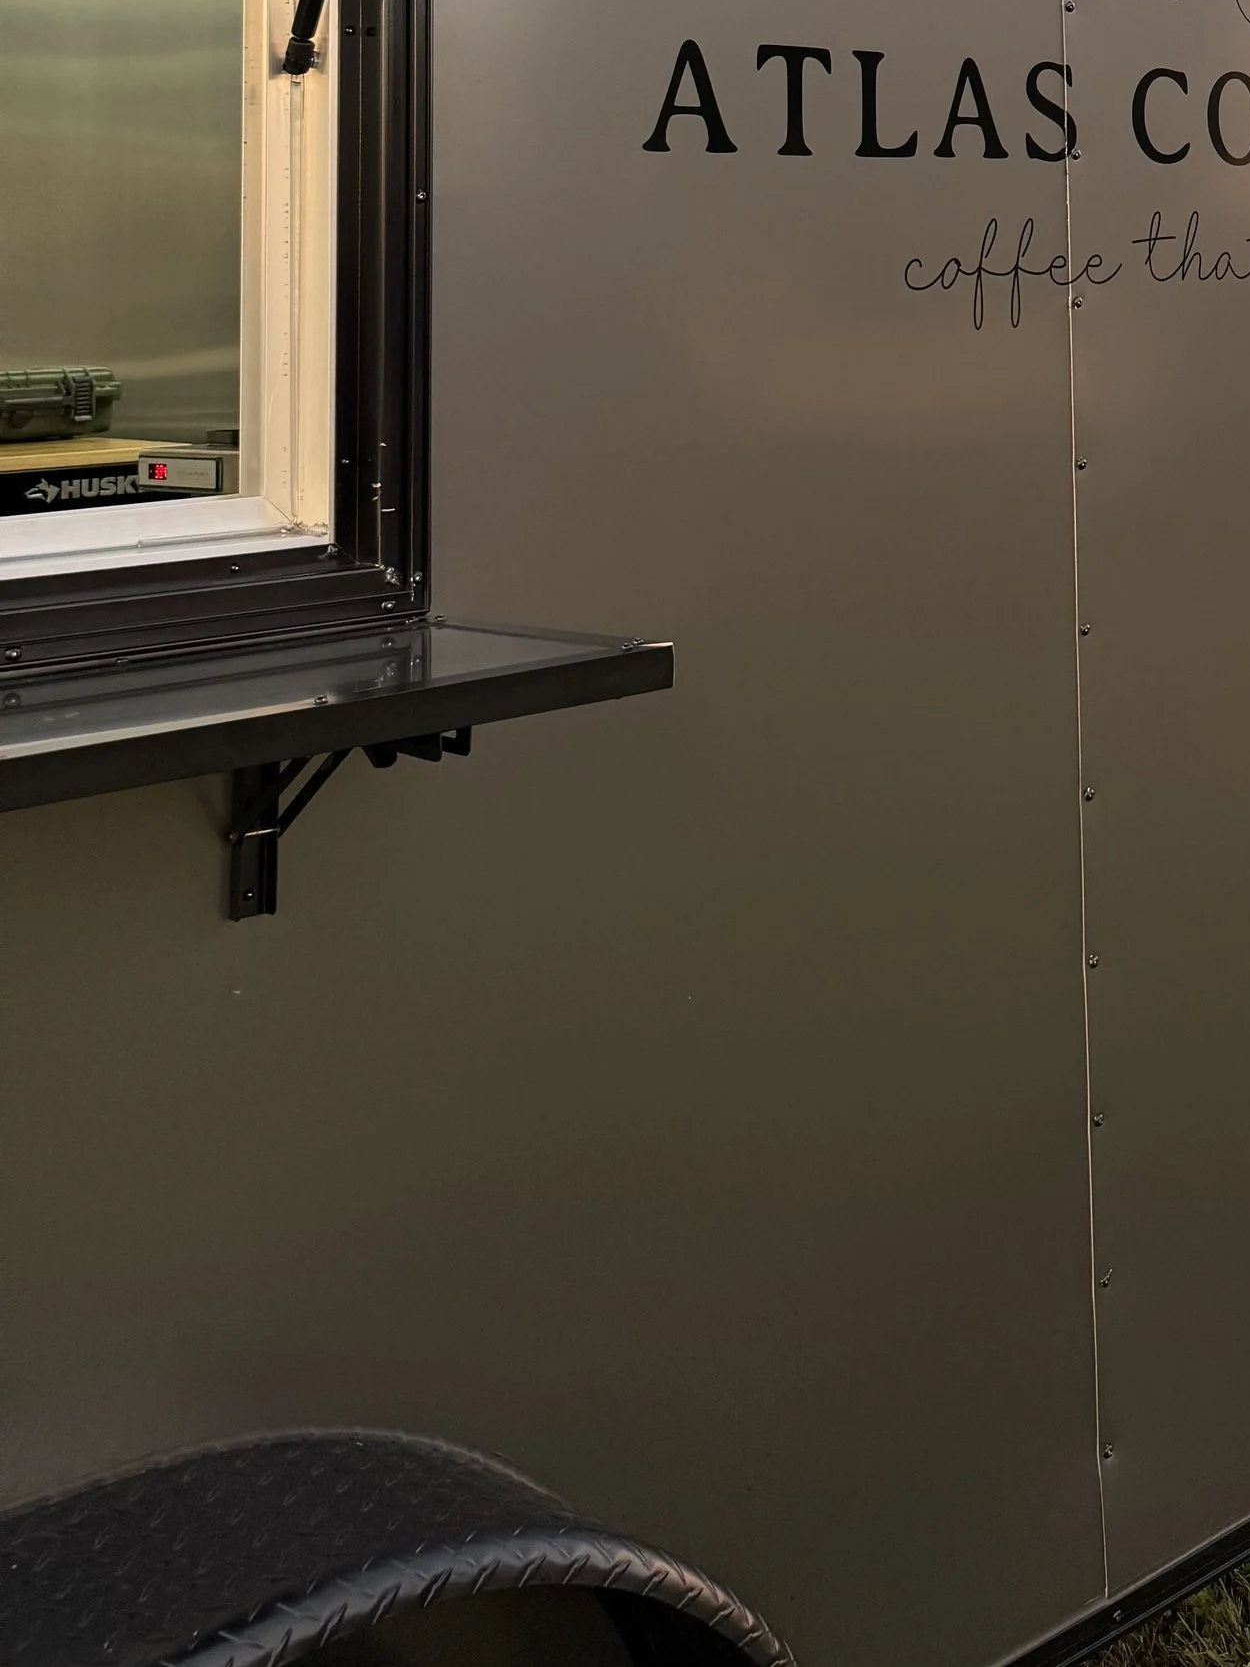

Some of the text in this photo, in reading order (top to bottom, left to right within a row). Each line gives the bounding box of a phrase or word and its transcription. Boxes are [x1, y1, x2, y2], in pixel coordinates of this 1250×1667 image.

[642, 39, 1077, 162] ATLAS
[904, 218, 1122, 330] coffee
[61, 475, 146, 499] HUSK
